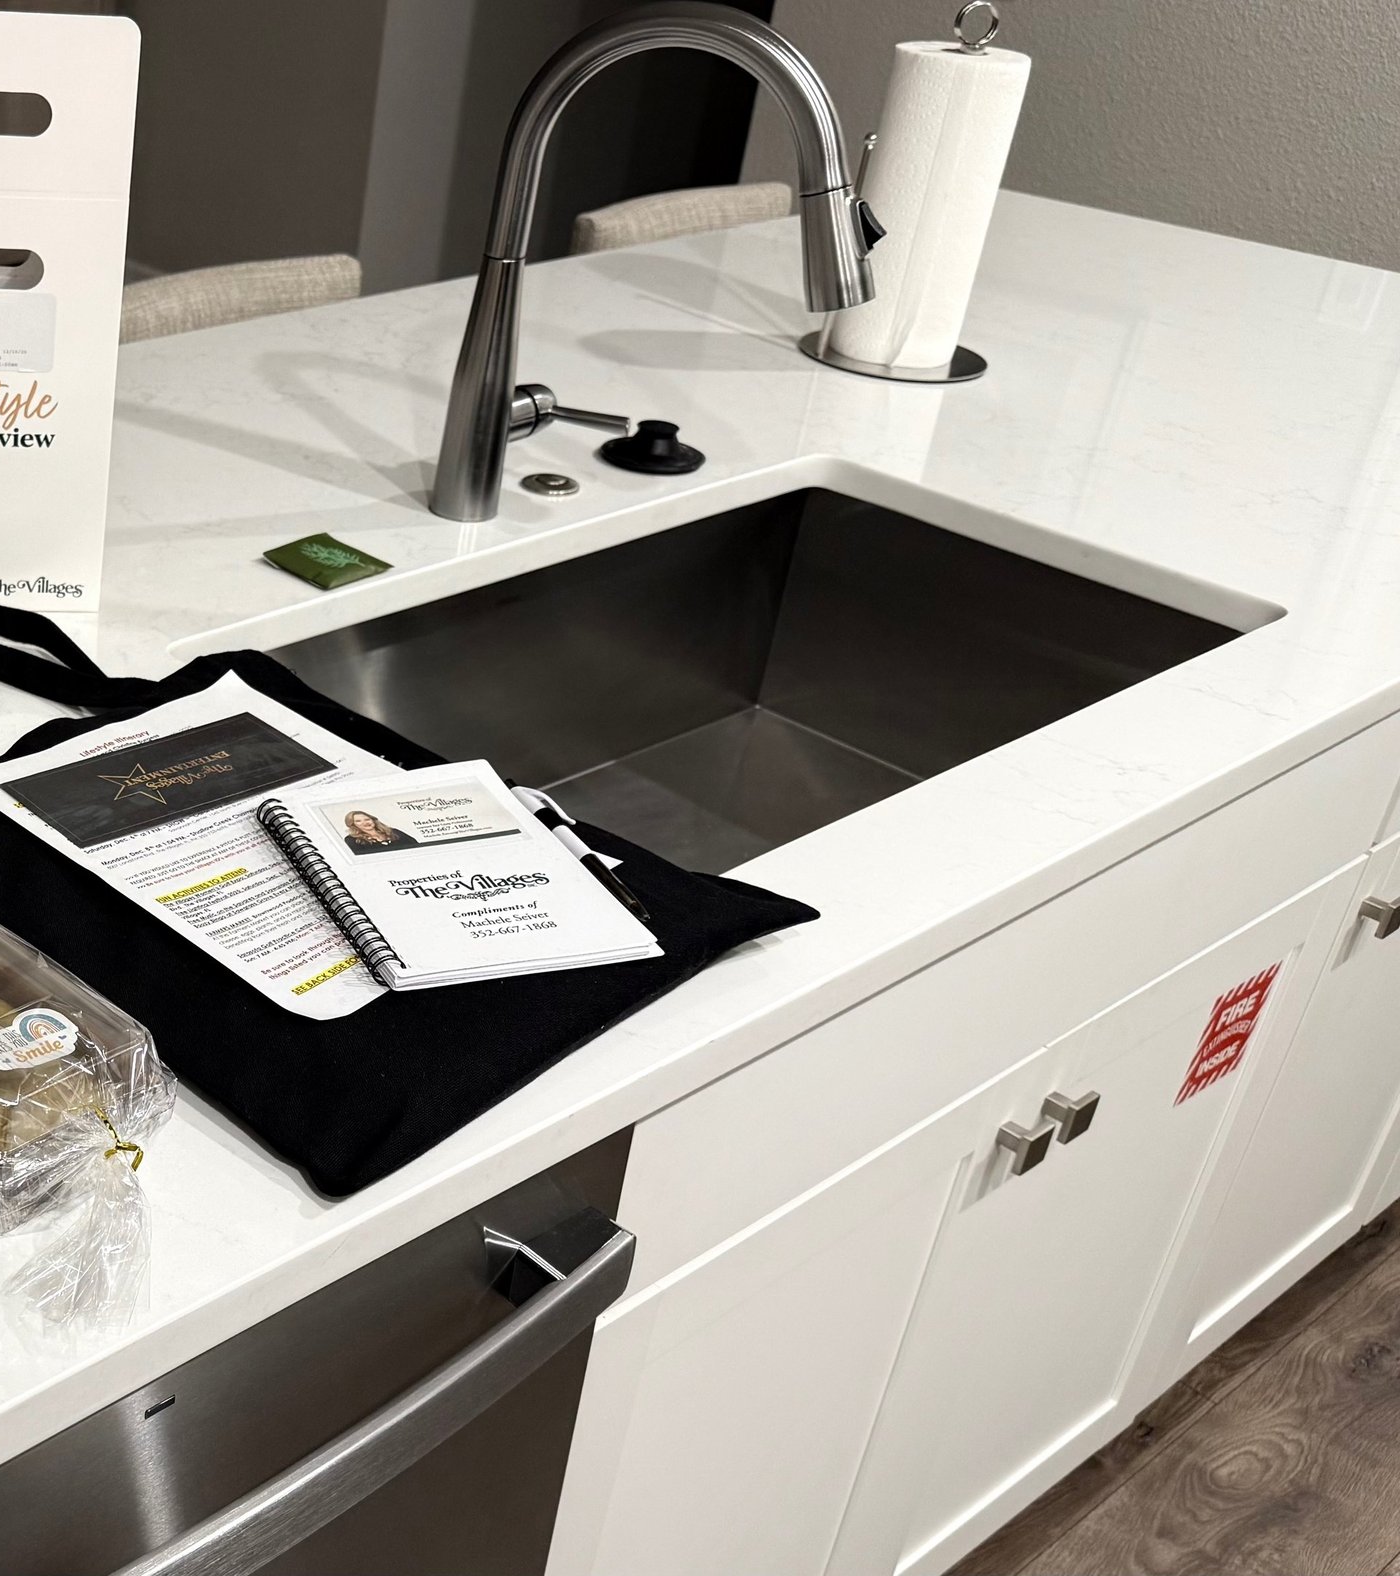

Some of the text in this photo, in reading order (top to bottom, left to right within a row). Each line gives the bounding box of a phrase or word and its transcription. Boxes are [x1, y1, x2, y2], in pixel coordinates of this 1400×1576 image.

[17, 576, 84, 599] Villages
[124, 751, 230, 787] ENTERTAINMENT
[146, 770, 206, 791] Villages
[420, 823, 474, 834] 352-667-1868
[101, 855, 128, 865] Monday,
[155, 895, 172, 903] FUN
[172, 883, 209, 898] ACTIVITIES
[220, 868, 246, 880] ATTEND
[388, 870, 463, 887] Properties of
[396, 873, 550, 899] The Villages
[452, 901, 538, 918] Compliments of
[461, 911, 549, 929] Machele Seiver
[470, 920, 557, 939] 352-667-1868
[268, 945, 334, 979] things listed you can
[271, 962, 285, 970] sure
[292, 950, 308, 959] look
[307, 937, 334, 951] through
[291, 985, 308, 995] SEE
[305, 973, 330, 987] BACK
[327, 963, 347, 975] SIDE
[1214, 990, 1261, 1031] FIRE
[12, 1037, 29, 1048] YOU
[13, 1040, 64, 1062] Smile
[1195, 1040, 1241, 1078] INSIDE
